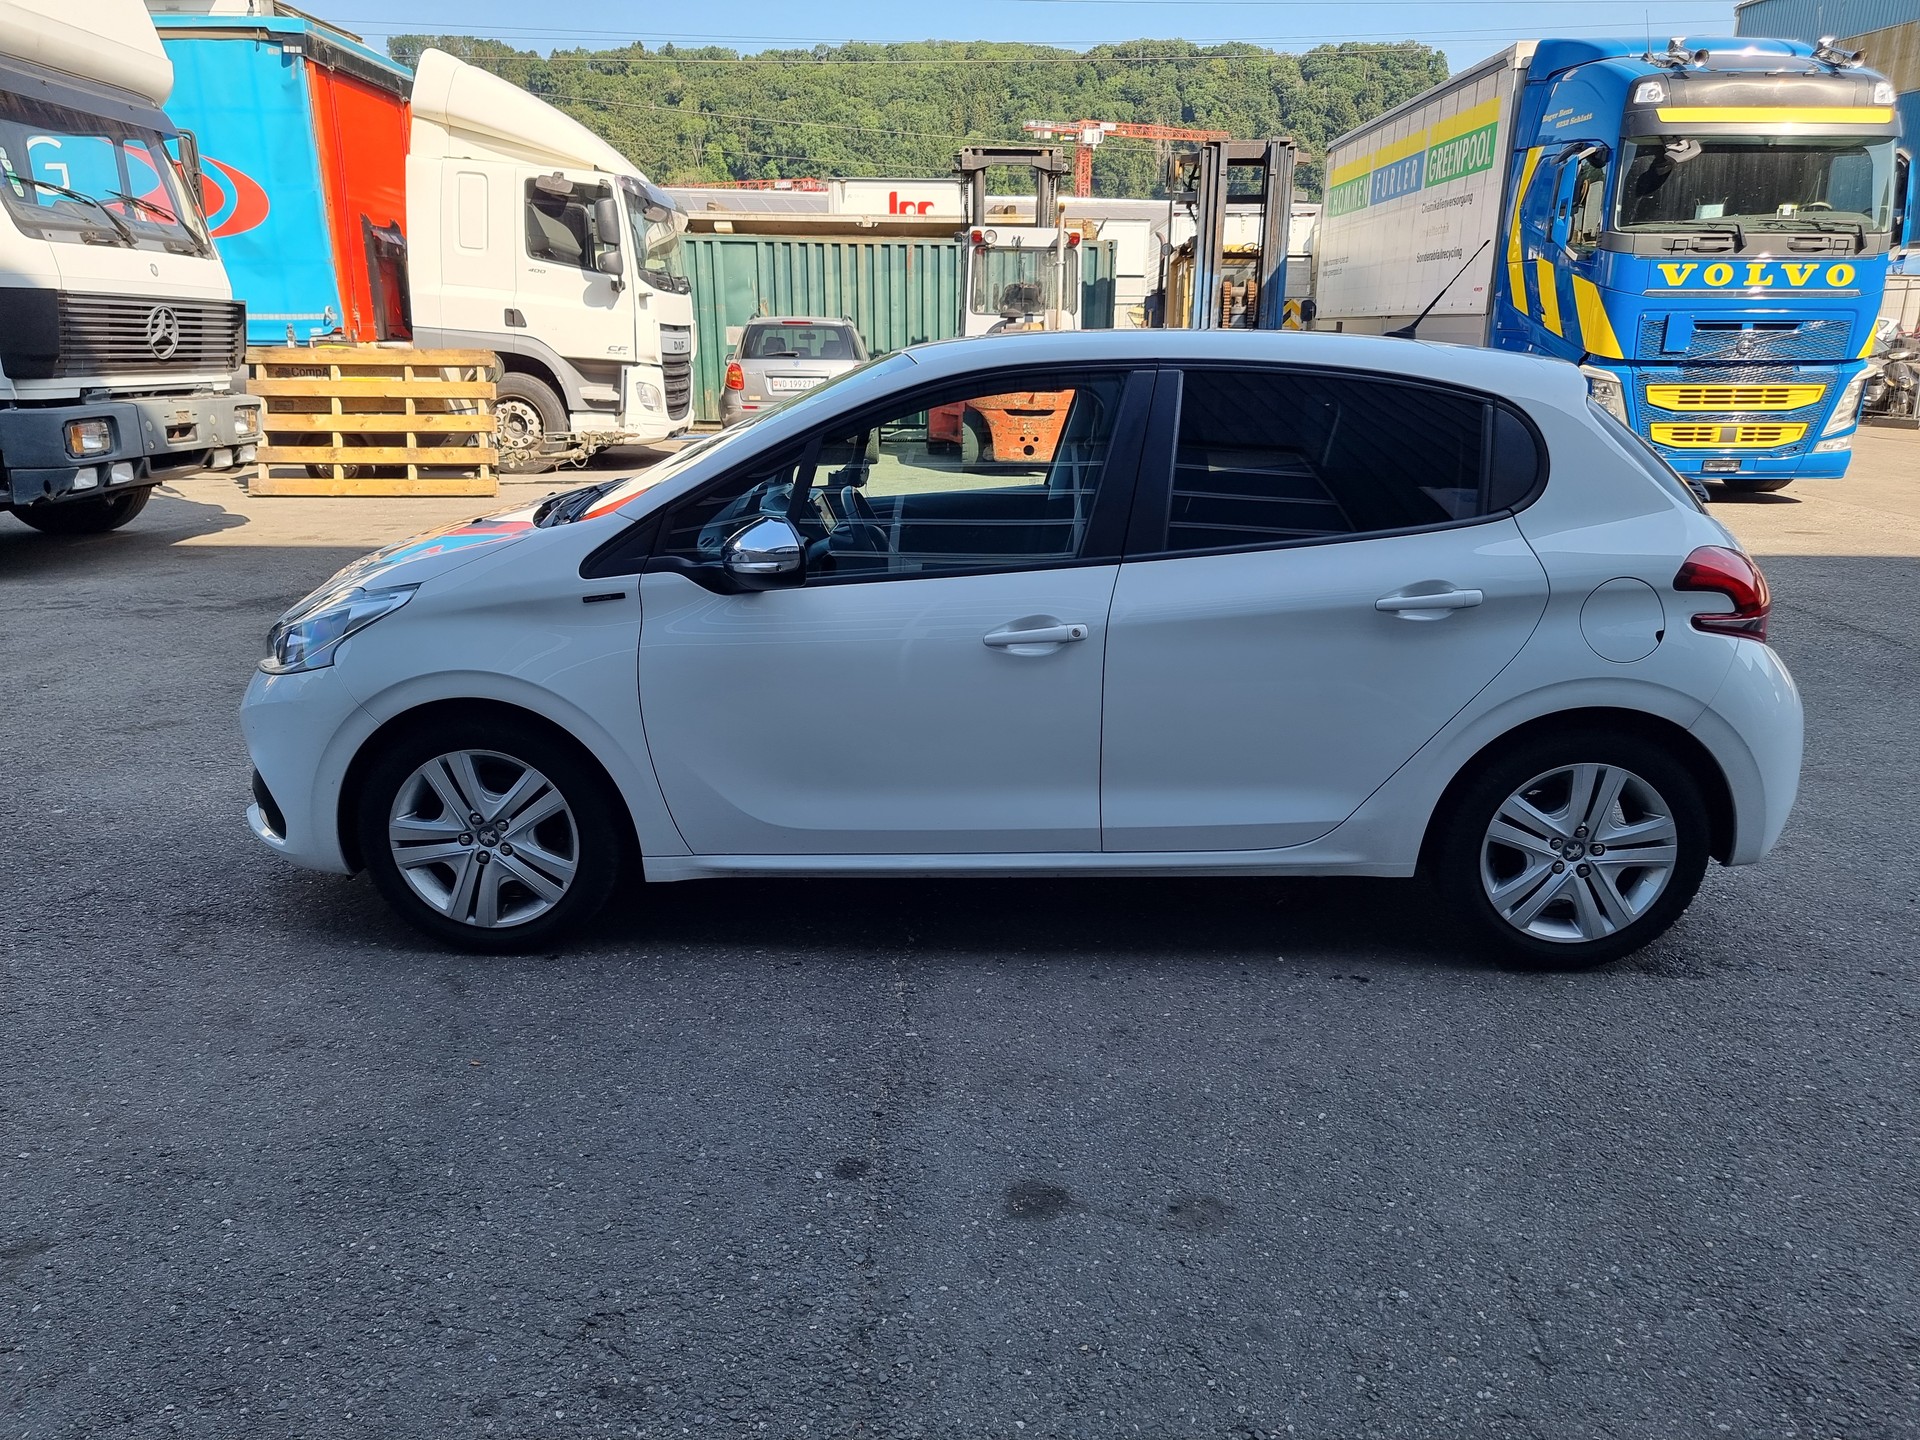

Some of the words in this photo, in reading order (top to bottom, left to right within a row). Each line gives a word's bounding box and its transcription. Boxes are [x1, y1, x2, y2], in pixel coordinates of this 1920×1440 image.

[26, 135, 70, 196] G
[1375, 158, 1419, 200] FURLER
[1427, 128, 1493, 183] GREENPOOL
[528, 267, 547, 275] 400
[1657, 262, 1856, 288] VOLVO
[673, 340, 686, 351] DAF
[778, 380, 787, 388] VD
